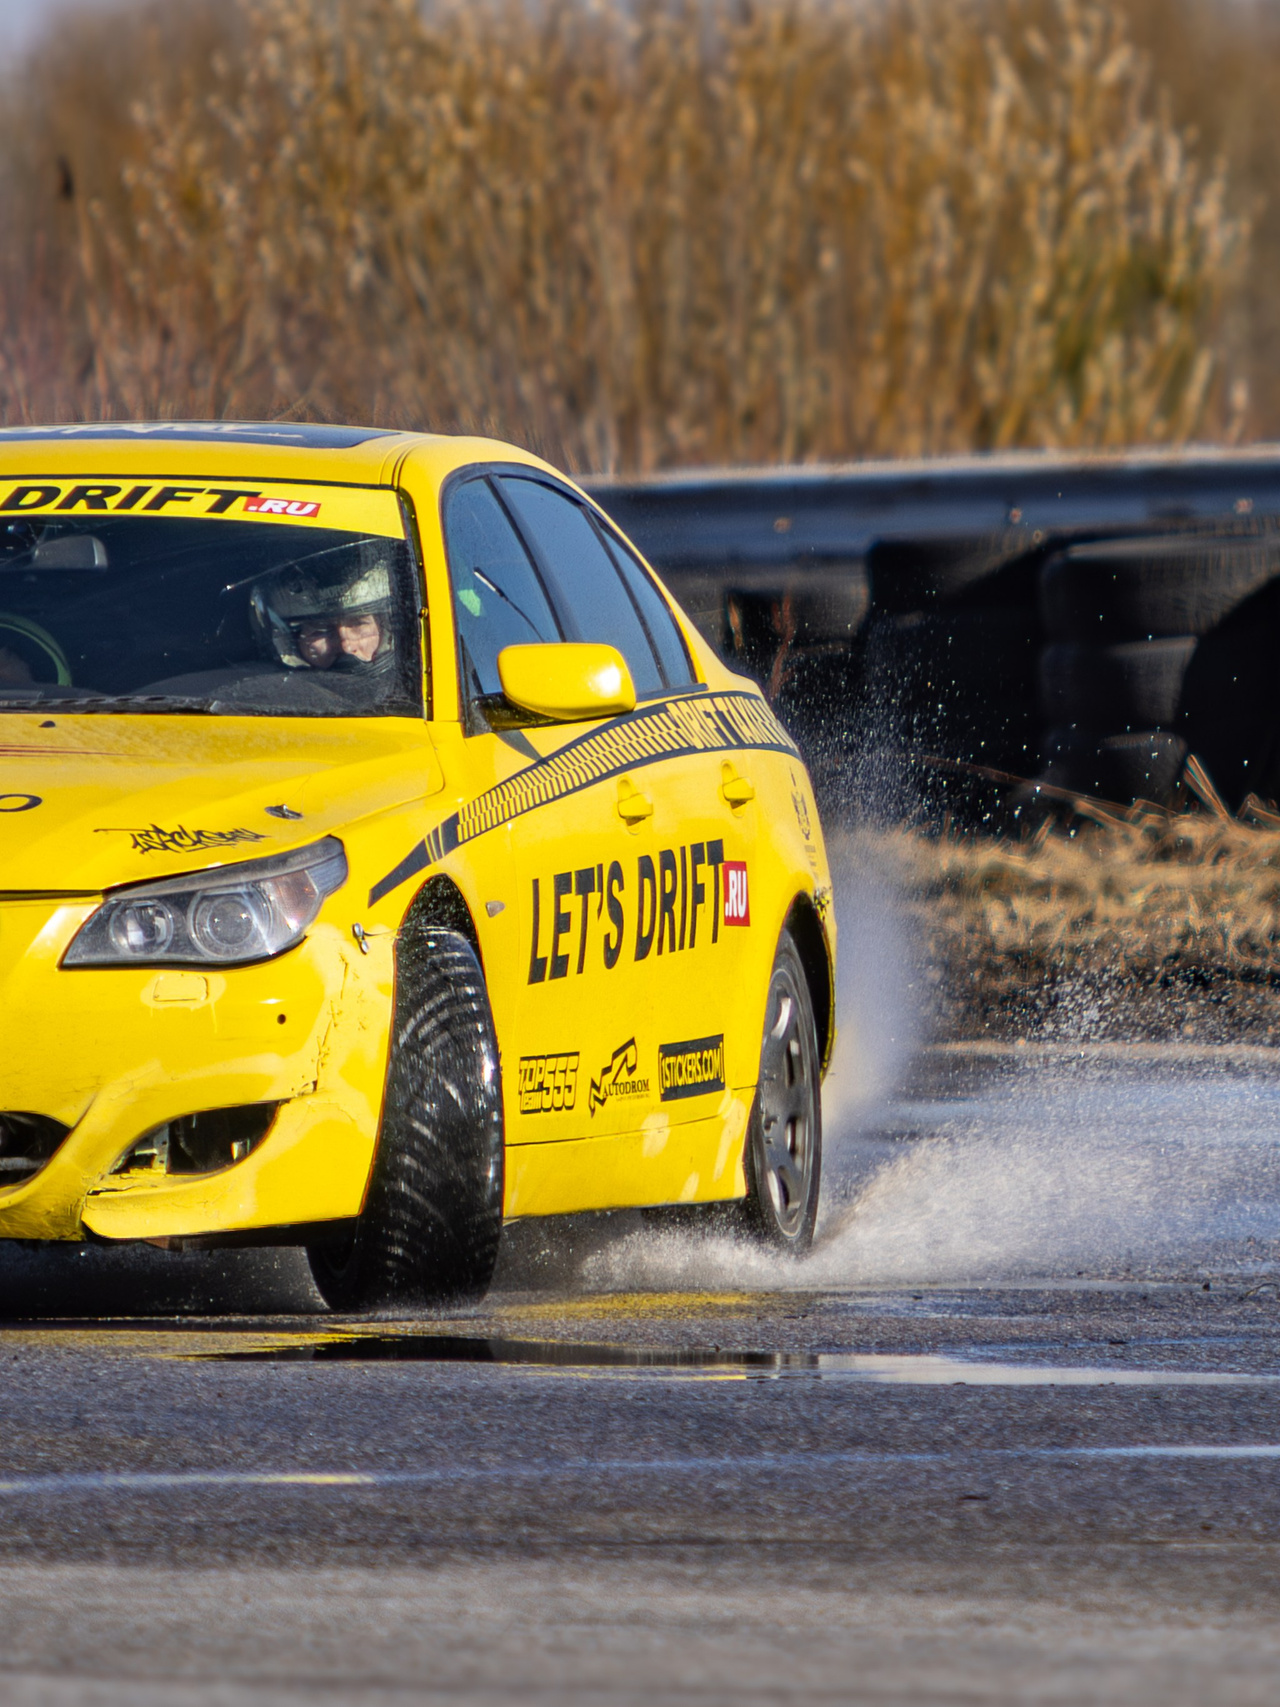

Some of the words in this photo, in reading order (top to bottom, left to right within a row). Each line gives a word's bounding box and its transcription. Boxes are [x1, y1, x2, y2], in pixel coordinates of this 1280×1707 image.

[665, 697, 739, 749] DRIFT
[527, 860, 625, 986] LET'S
[602, 1078, 650, 1098] AUTODROM
